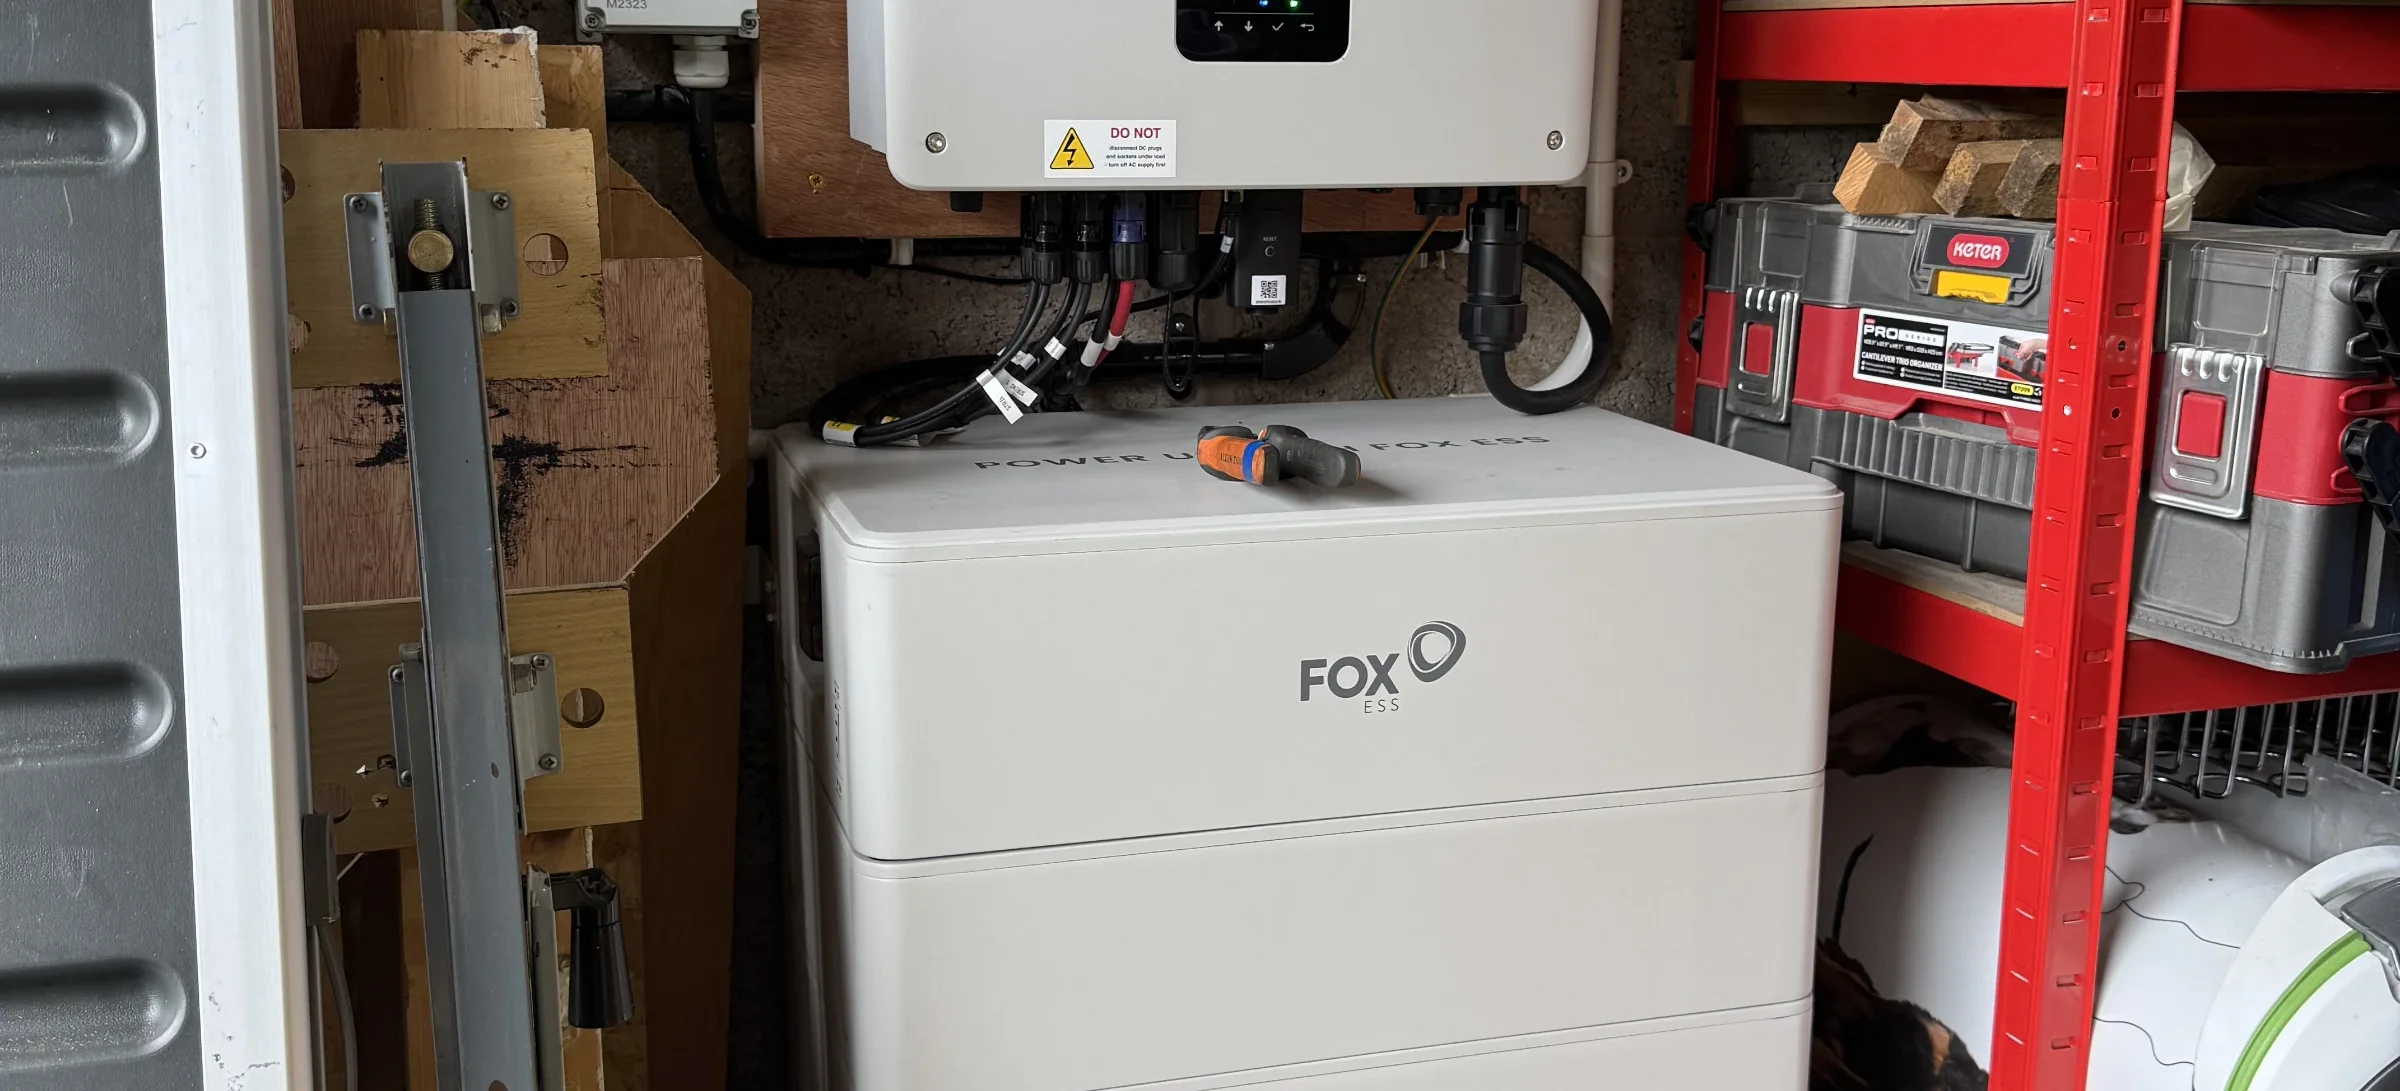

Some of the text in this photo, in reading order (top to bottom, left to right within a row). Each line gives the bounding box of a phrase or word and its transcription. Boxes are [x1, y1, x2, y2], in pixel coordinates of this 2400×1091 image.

[607, 0, 648, 9] M2323
[1110, 128, 1161, 138] DO NOT
[1864, 324, 1936, 343] PRO SERIES
[1862, 352, 1896, 364] CANTILEVER
[1896, 357, 1910, 366] TRIO
[1910, 360, 1943, 372] ORGANIZER
[974, 454, 1149, 469] POWER
[1369, 440, 1462, 450] FOX
[1470, 436, 1550, 446] ESS
[1300, 653, 1400, 702] FOX
[1364, 698, 1399, 714] ESS
